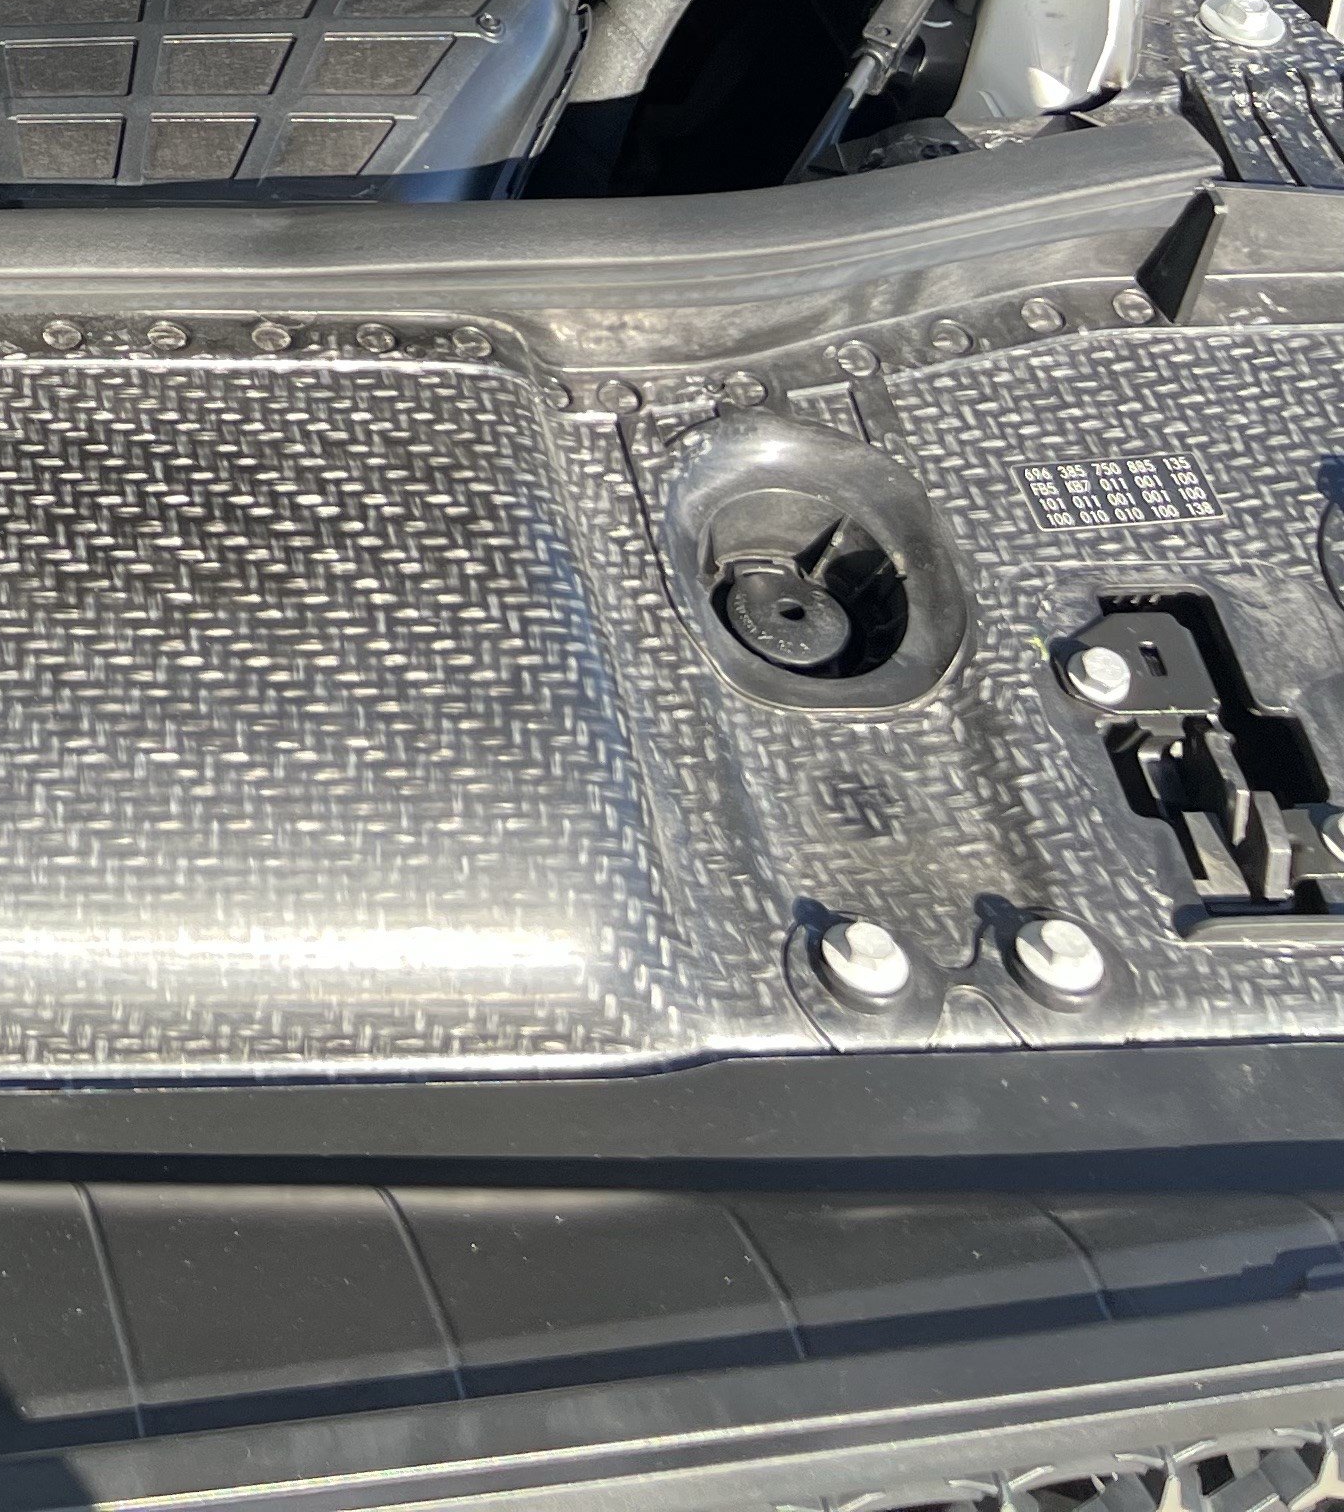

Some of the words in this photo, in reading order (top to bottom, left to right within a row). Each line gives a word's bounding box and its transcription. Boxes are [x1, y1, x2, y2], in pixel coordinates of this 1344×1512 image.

[1024, 467, 1053, 482] 696
[1091, 462, 1122, 477] 750
[1162, 456, 1192, 472] 135
[1099, 477, 1129, 492] 011
[1134, 474, 1163, 489] 001
[1170, 471, 1200, 487] 100
[1039, 497, 1067, 513] 101
[1072, 494, 1102, 510] 011
[1107, 492, 1137, 507] 001
[1141, 489, 1172, 504] 001
[1177, 486, 1208, 502] 100
[1046, 511, 1075, 527] 100
[1079, 509, 1111, 524] 010
[1114, 506, 1146, 523] 010
[1151, 504, 1181, 520] 100
[1185, 501, 1215, 517] 138
